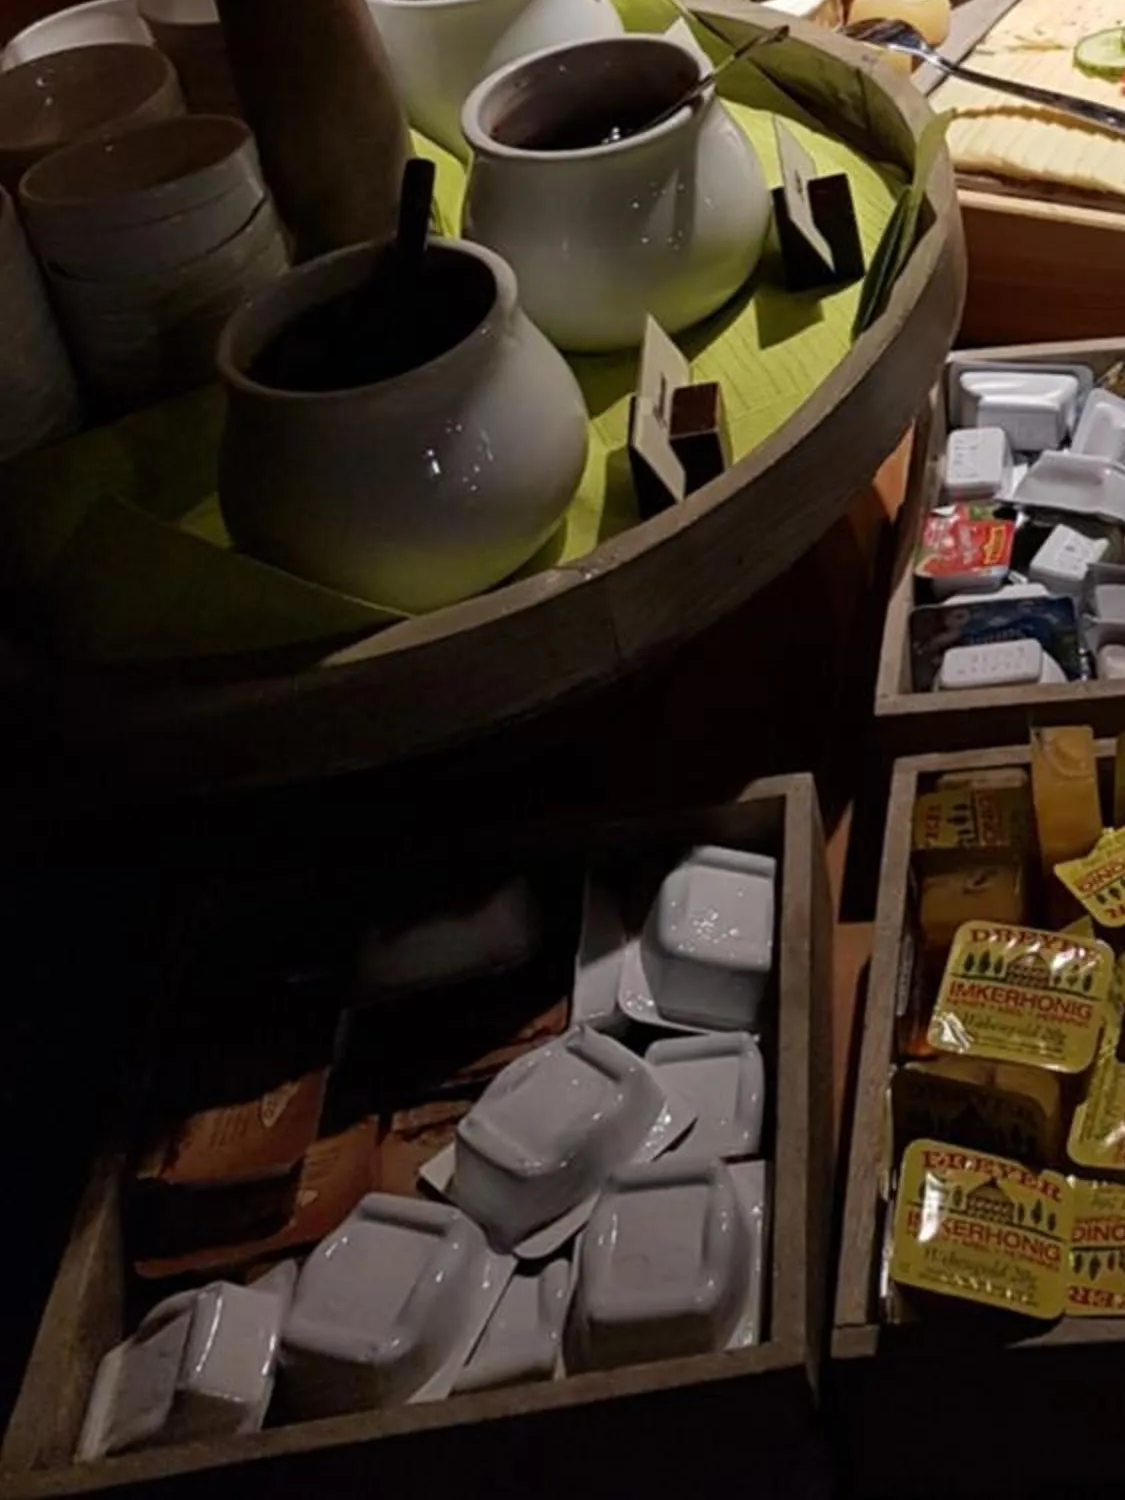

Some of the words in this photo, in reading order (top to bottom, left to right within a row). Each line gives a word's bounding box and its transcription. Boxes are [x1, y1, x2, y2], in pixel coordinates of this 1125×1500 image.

[950, 981, 1093, 1020] IMKERHONIG
[923, 1151, 1062, 1201] DREYER
[907, 1208, 1062, 1263] IKERHONIG
